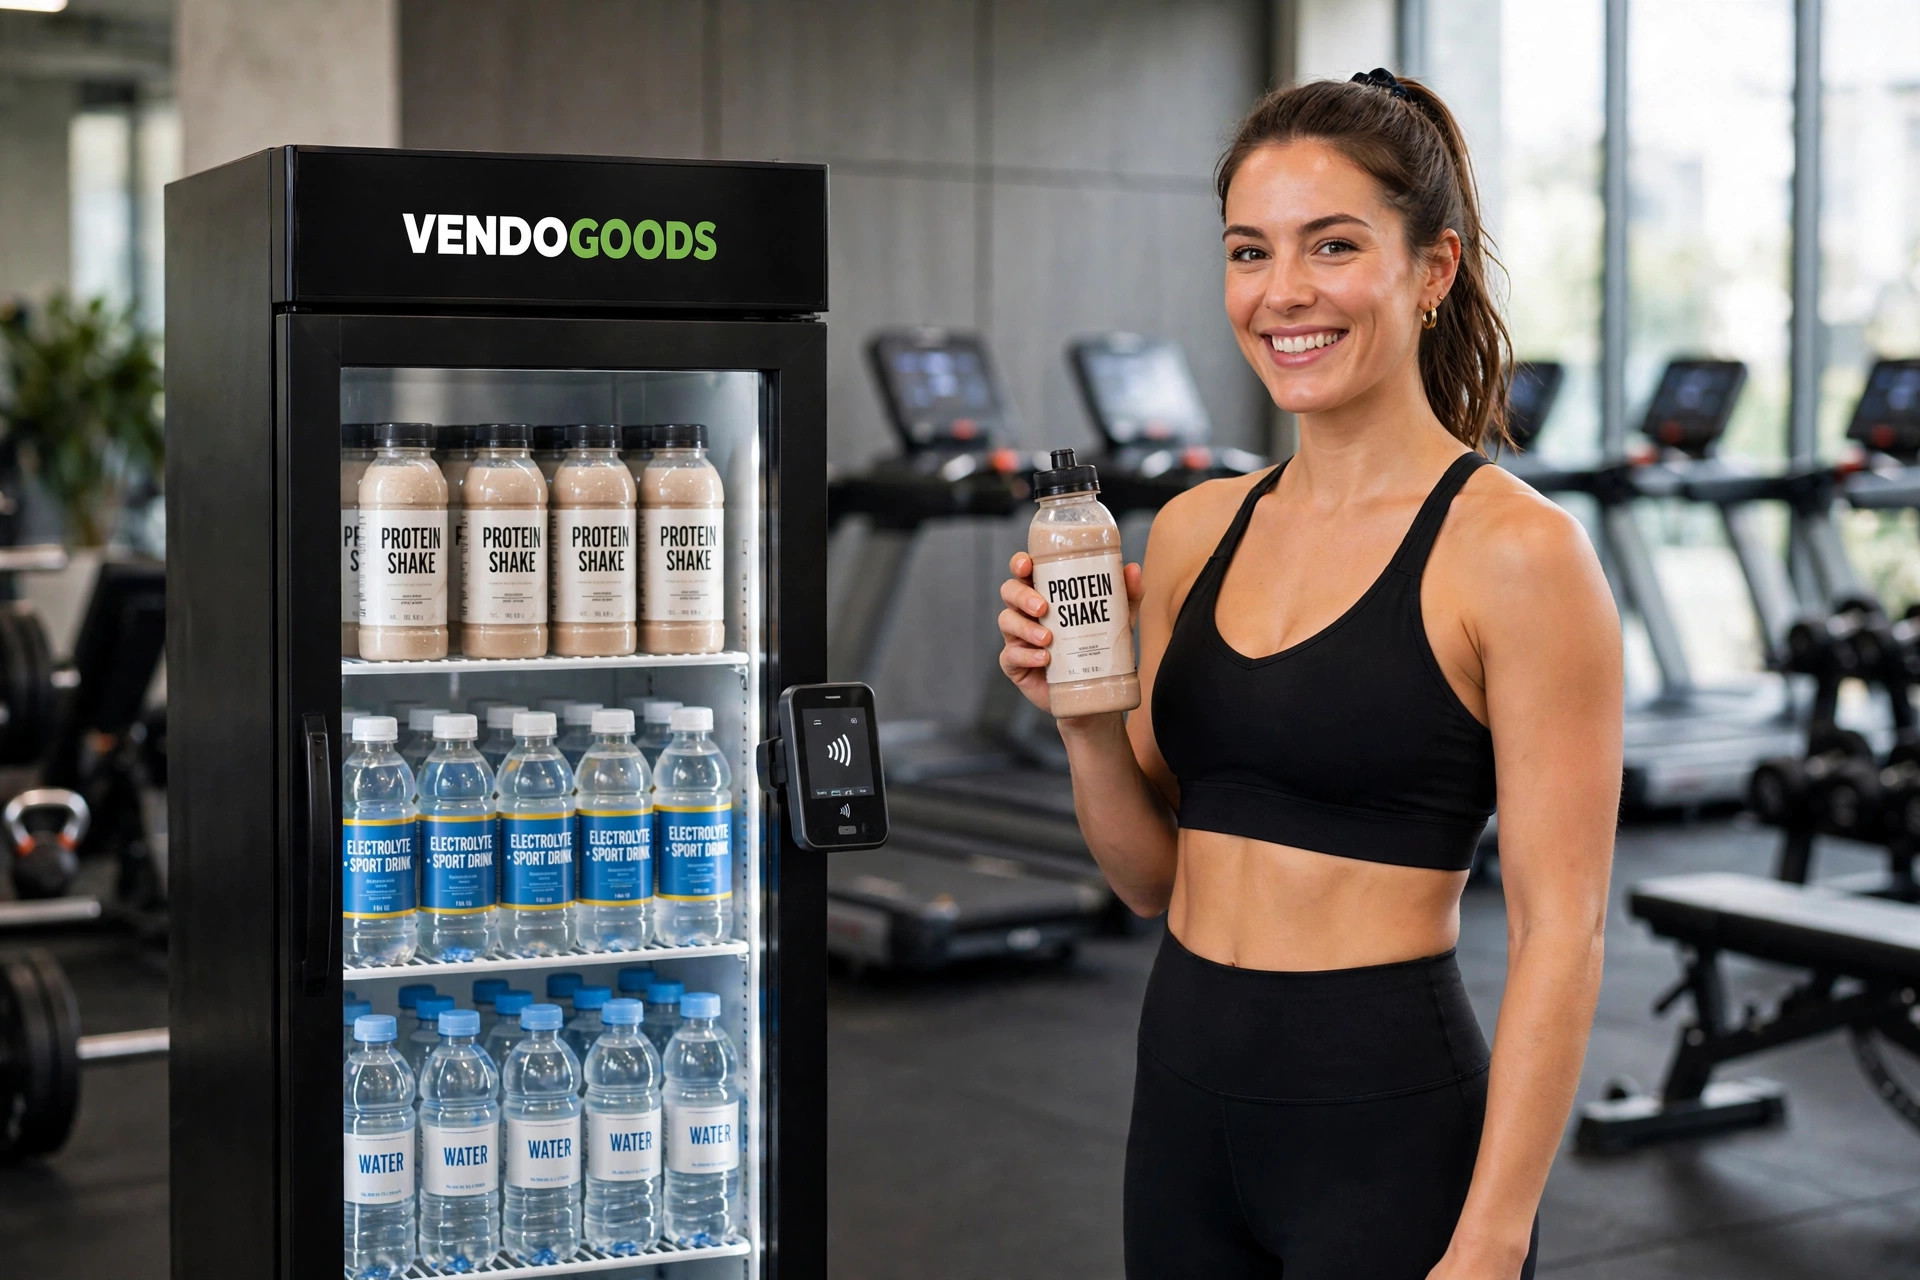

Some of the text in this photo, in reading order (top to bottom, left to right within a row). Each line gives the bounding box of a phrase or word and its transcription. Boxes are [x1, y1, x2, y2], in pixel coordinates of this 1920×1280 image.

[402, 213, 717, 260] VENDOGOODS
[381, 527, 441, 549] PROTEIN
[482, 527, 541, 548] PROTEIN
[571, 526, 630, 548] PROTEIN
[660, 525, 717, 547] PROTEIN
[387, 552, 436, 574] SHAKE
[488, 551, 536, 573] SHAKE
[578, 550, 625, 572] SHAKE
[666, 549, 712, 571] SHAKE
[1048, 572, 1113, 603] PROTEIN
[1057, 599, 1110, 628] SHAKE
[430, 834, 492, 852] ELECTROLYTE
[510, 832, 572, 849] ELECTROLYTE
[589, 828, 650, 845] ELECTROLYTE
[668, 823, 729, 841] ELECTROLYTE
[347, 838, 411, 855] ELECTROLYTE
[513, 848, 572, 866] SPORT DRINK
[592, 845, 650, 862] SPORT DRINK
[671, 841, 729, 858] SPORT DRINK
[349, 856, 411, 873] SPORT DRINK
[432, 851, 493, 869] SPORT DRINK
[610, 1131, 652, 1153] WATER
[689, 1124, 731, 1146] WATER
[443, 1145, 488, 1167] WATER
[528, 1138, 572, 1160] WATER
[358, 1152, 404, 1175] WATER
